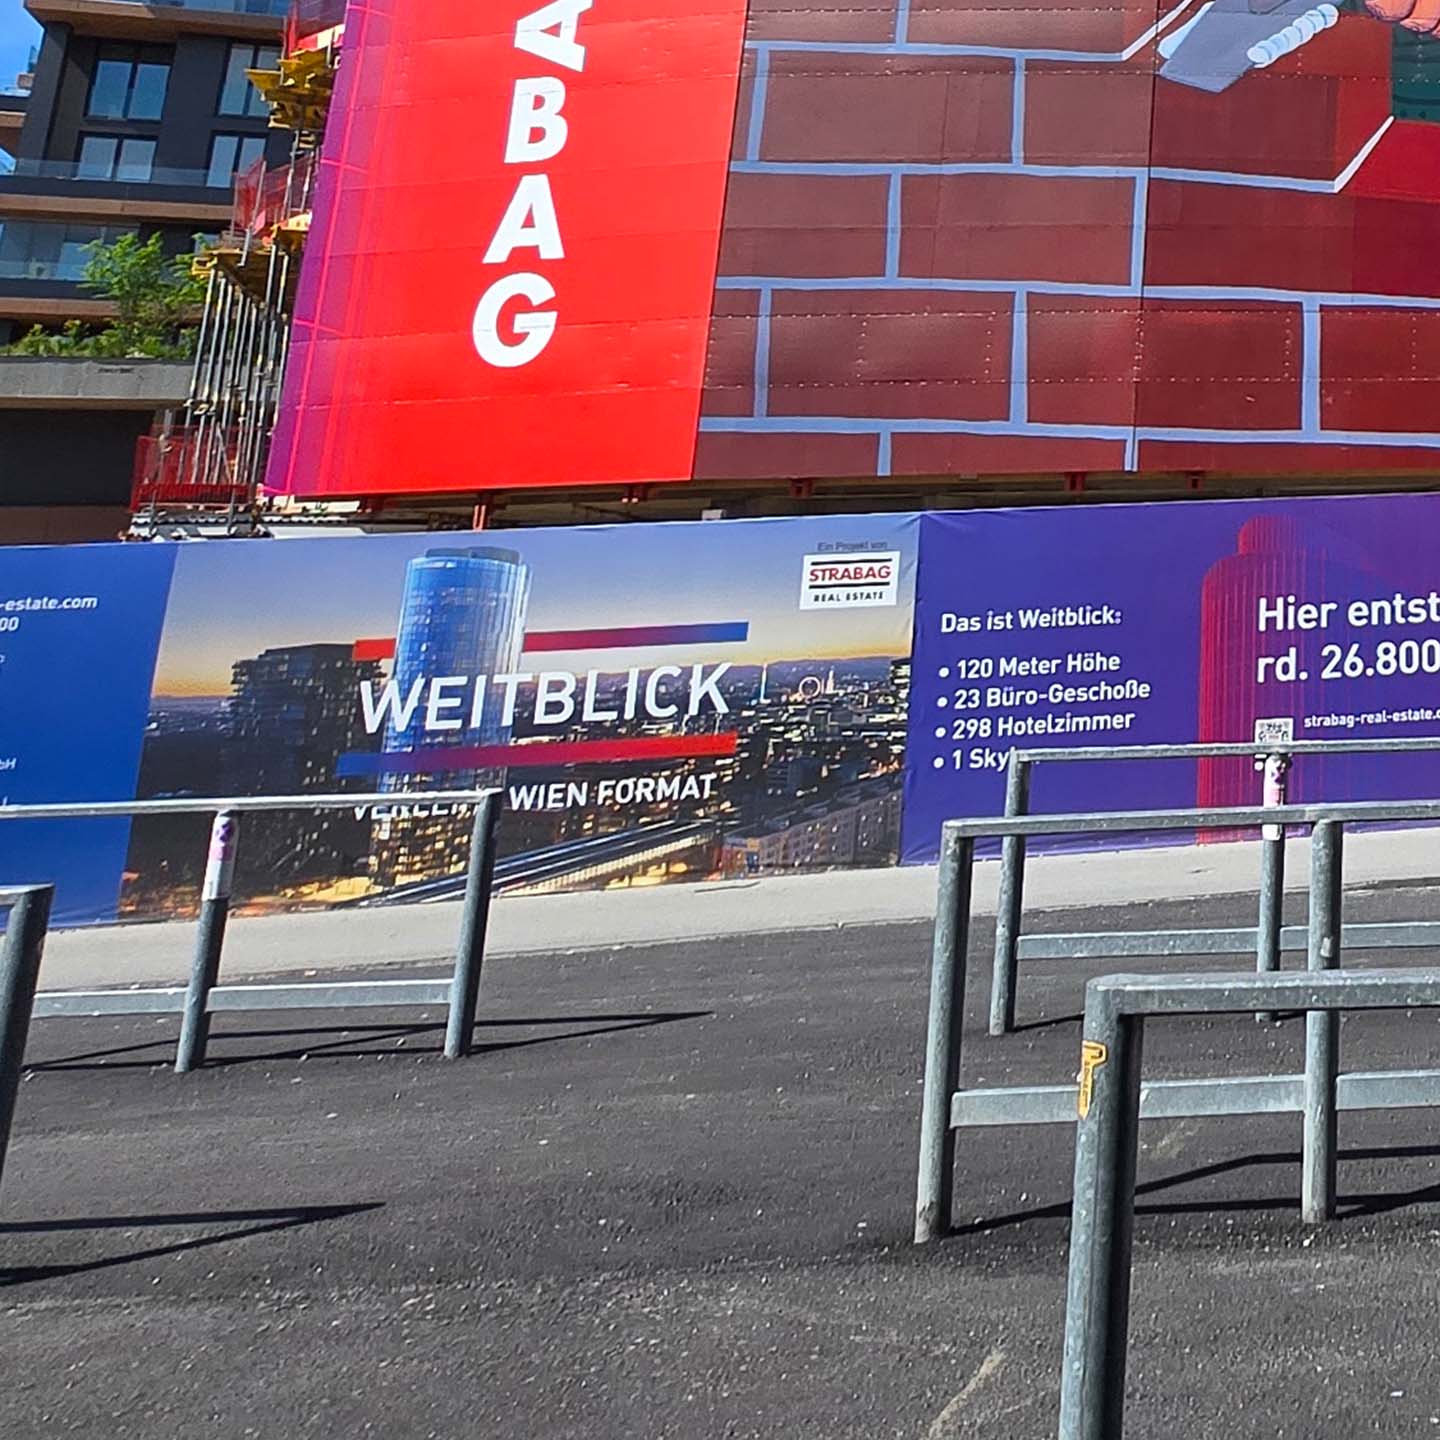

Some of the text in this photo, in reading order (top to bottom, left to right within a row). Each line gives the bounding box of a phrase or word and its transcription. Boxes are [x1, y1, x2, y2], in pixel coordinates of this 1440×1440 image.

[809, 565, 892, 581] STRABAG
[813, 591, 884, 602] REAL ESTATE
[940, 605, 1122, 633] Das ist Weitblick:
[1257, 595, 1338, 632] Hier
[957, 650, 1121, 679] 120 Meter Höhe
[1256, 647, 1308, 684] rd.
[359, 661, 733, 735] WEITBLICK
[954, 679, 1151, 710] 23 Büro-Geschoße
[951, 710, 1136, 740] 298 Hotelzimmer
[952, 750, 961, 769] 1
[508, 781, 588, 811] WIEN
[596, 772, 717, 806] FORMAT
